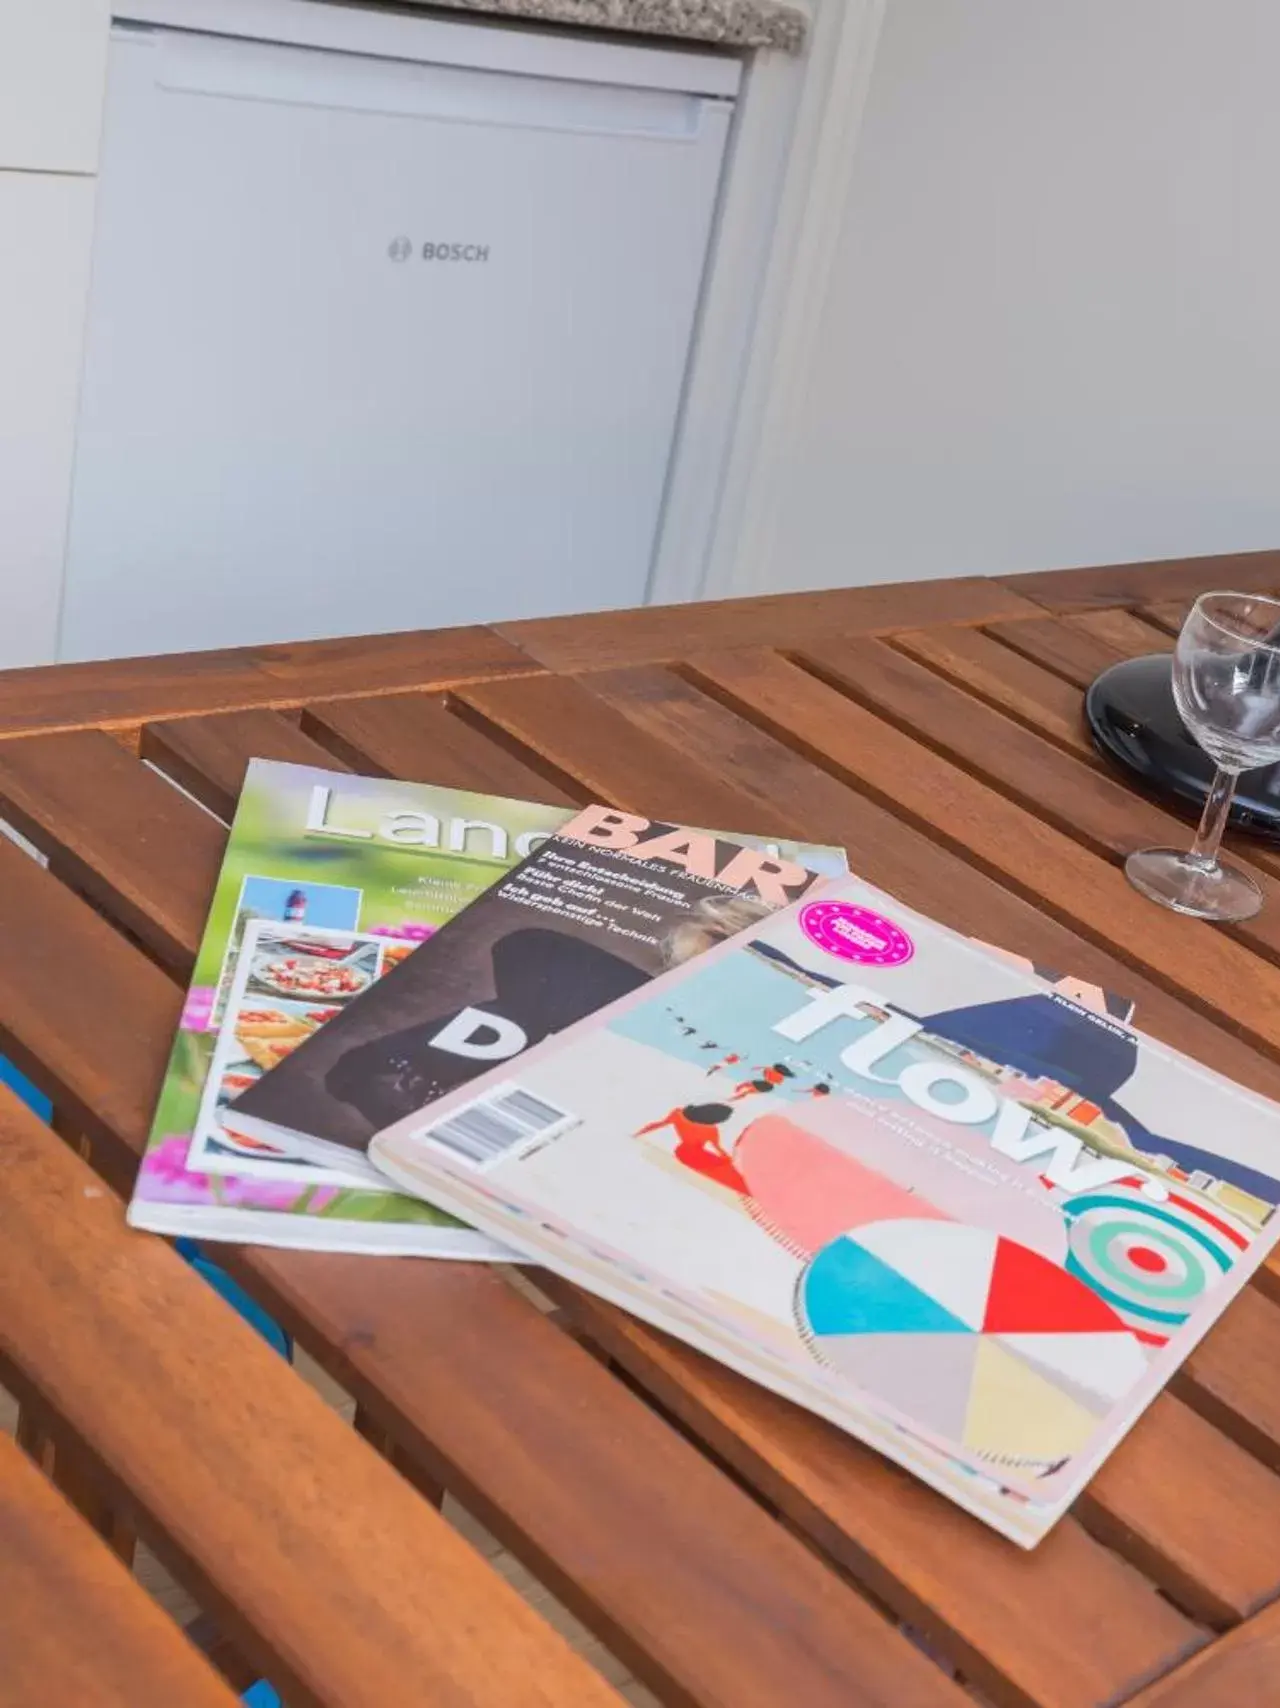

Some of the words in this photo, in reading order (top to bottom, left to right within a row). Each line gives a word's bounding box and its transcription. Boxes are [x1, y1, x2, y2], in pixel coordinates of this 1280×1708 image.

[422, 241, 491, 261] BOSCH
[552, 834, 587, 851] KEIN
[588, 843, 668, 875] NORMALES
[553, 803, 808, 910] BAR
[502, 882, 529, 898] Ich
[576, 860, 686, 901] Entscheidung
[603, 899, 630, 912] der
[643, 888, 692, 911] Frauen
[606, 921, 660, 946] Technik
